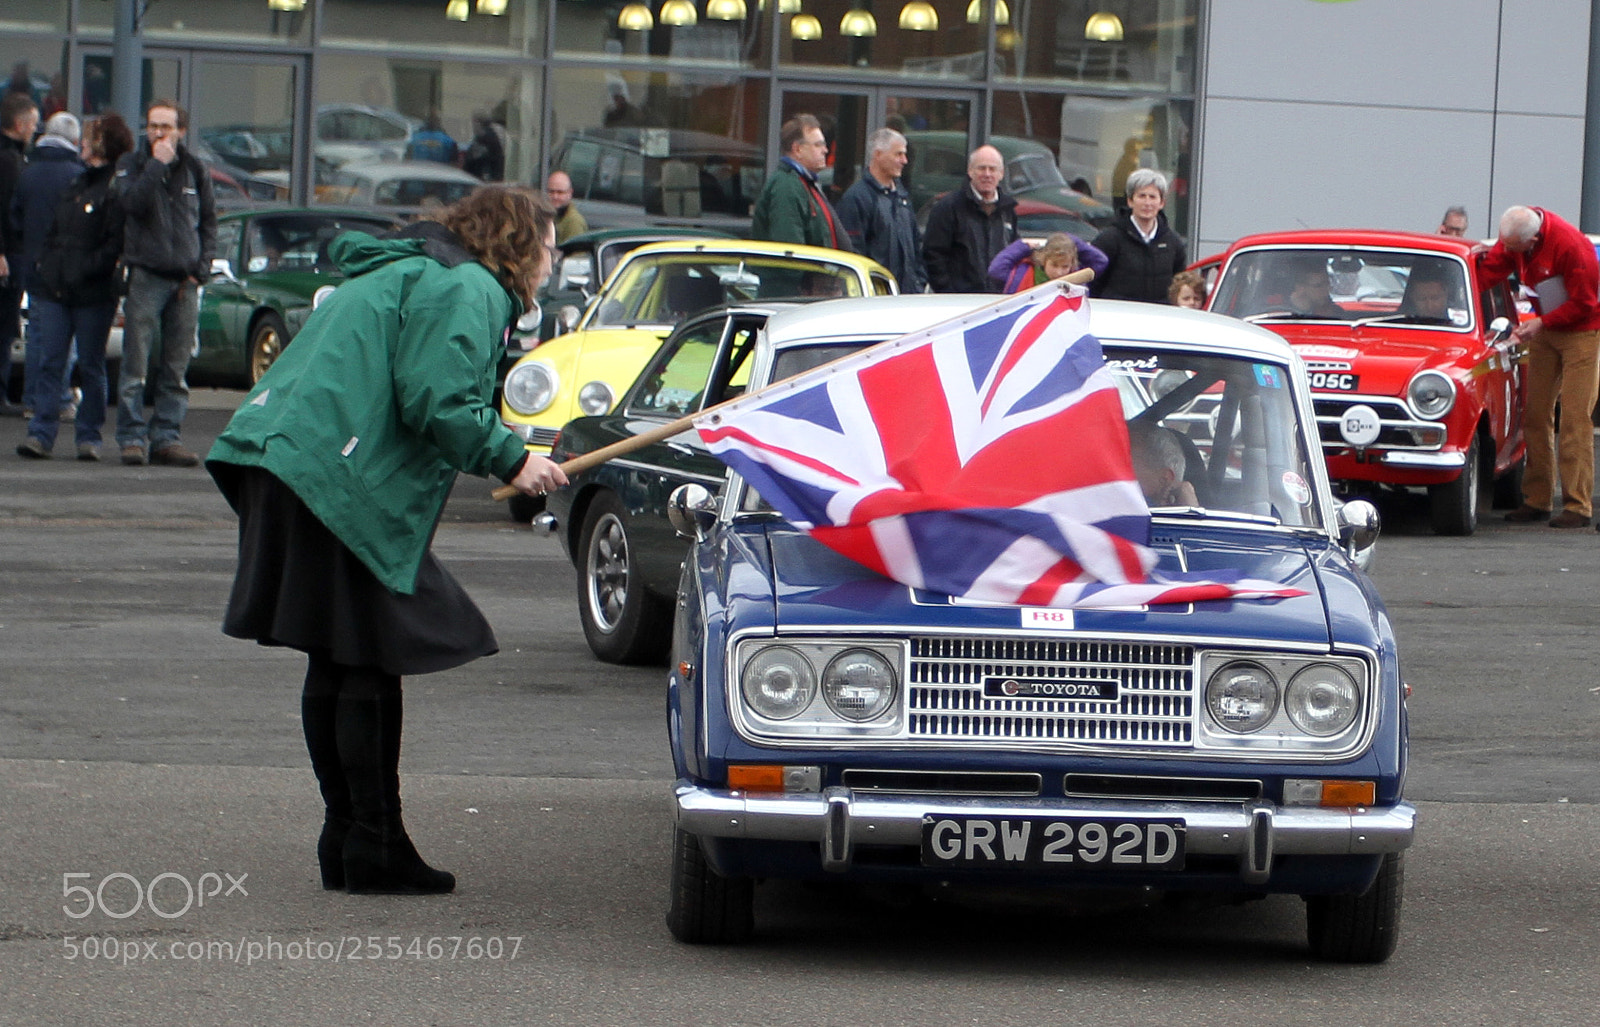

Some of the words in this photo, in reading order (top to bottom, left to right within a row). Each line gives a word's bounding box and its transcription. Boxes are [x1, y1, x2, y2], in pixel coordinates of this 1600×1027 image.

[1102, 354, 1159, 369] port
[1033, 611, 1065, 622] R8
[1031, 683, 1101, 696] TOYOTA
[931, 819, 1032, 862] GRW
[1043, 822, 1177, 864] 292D
